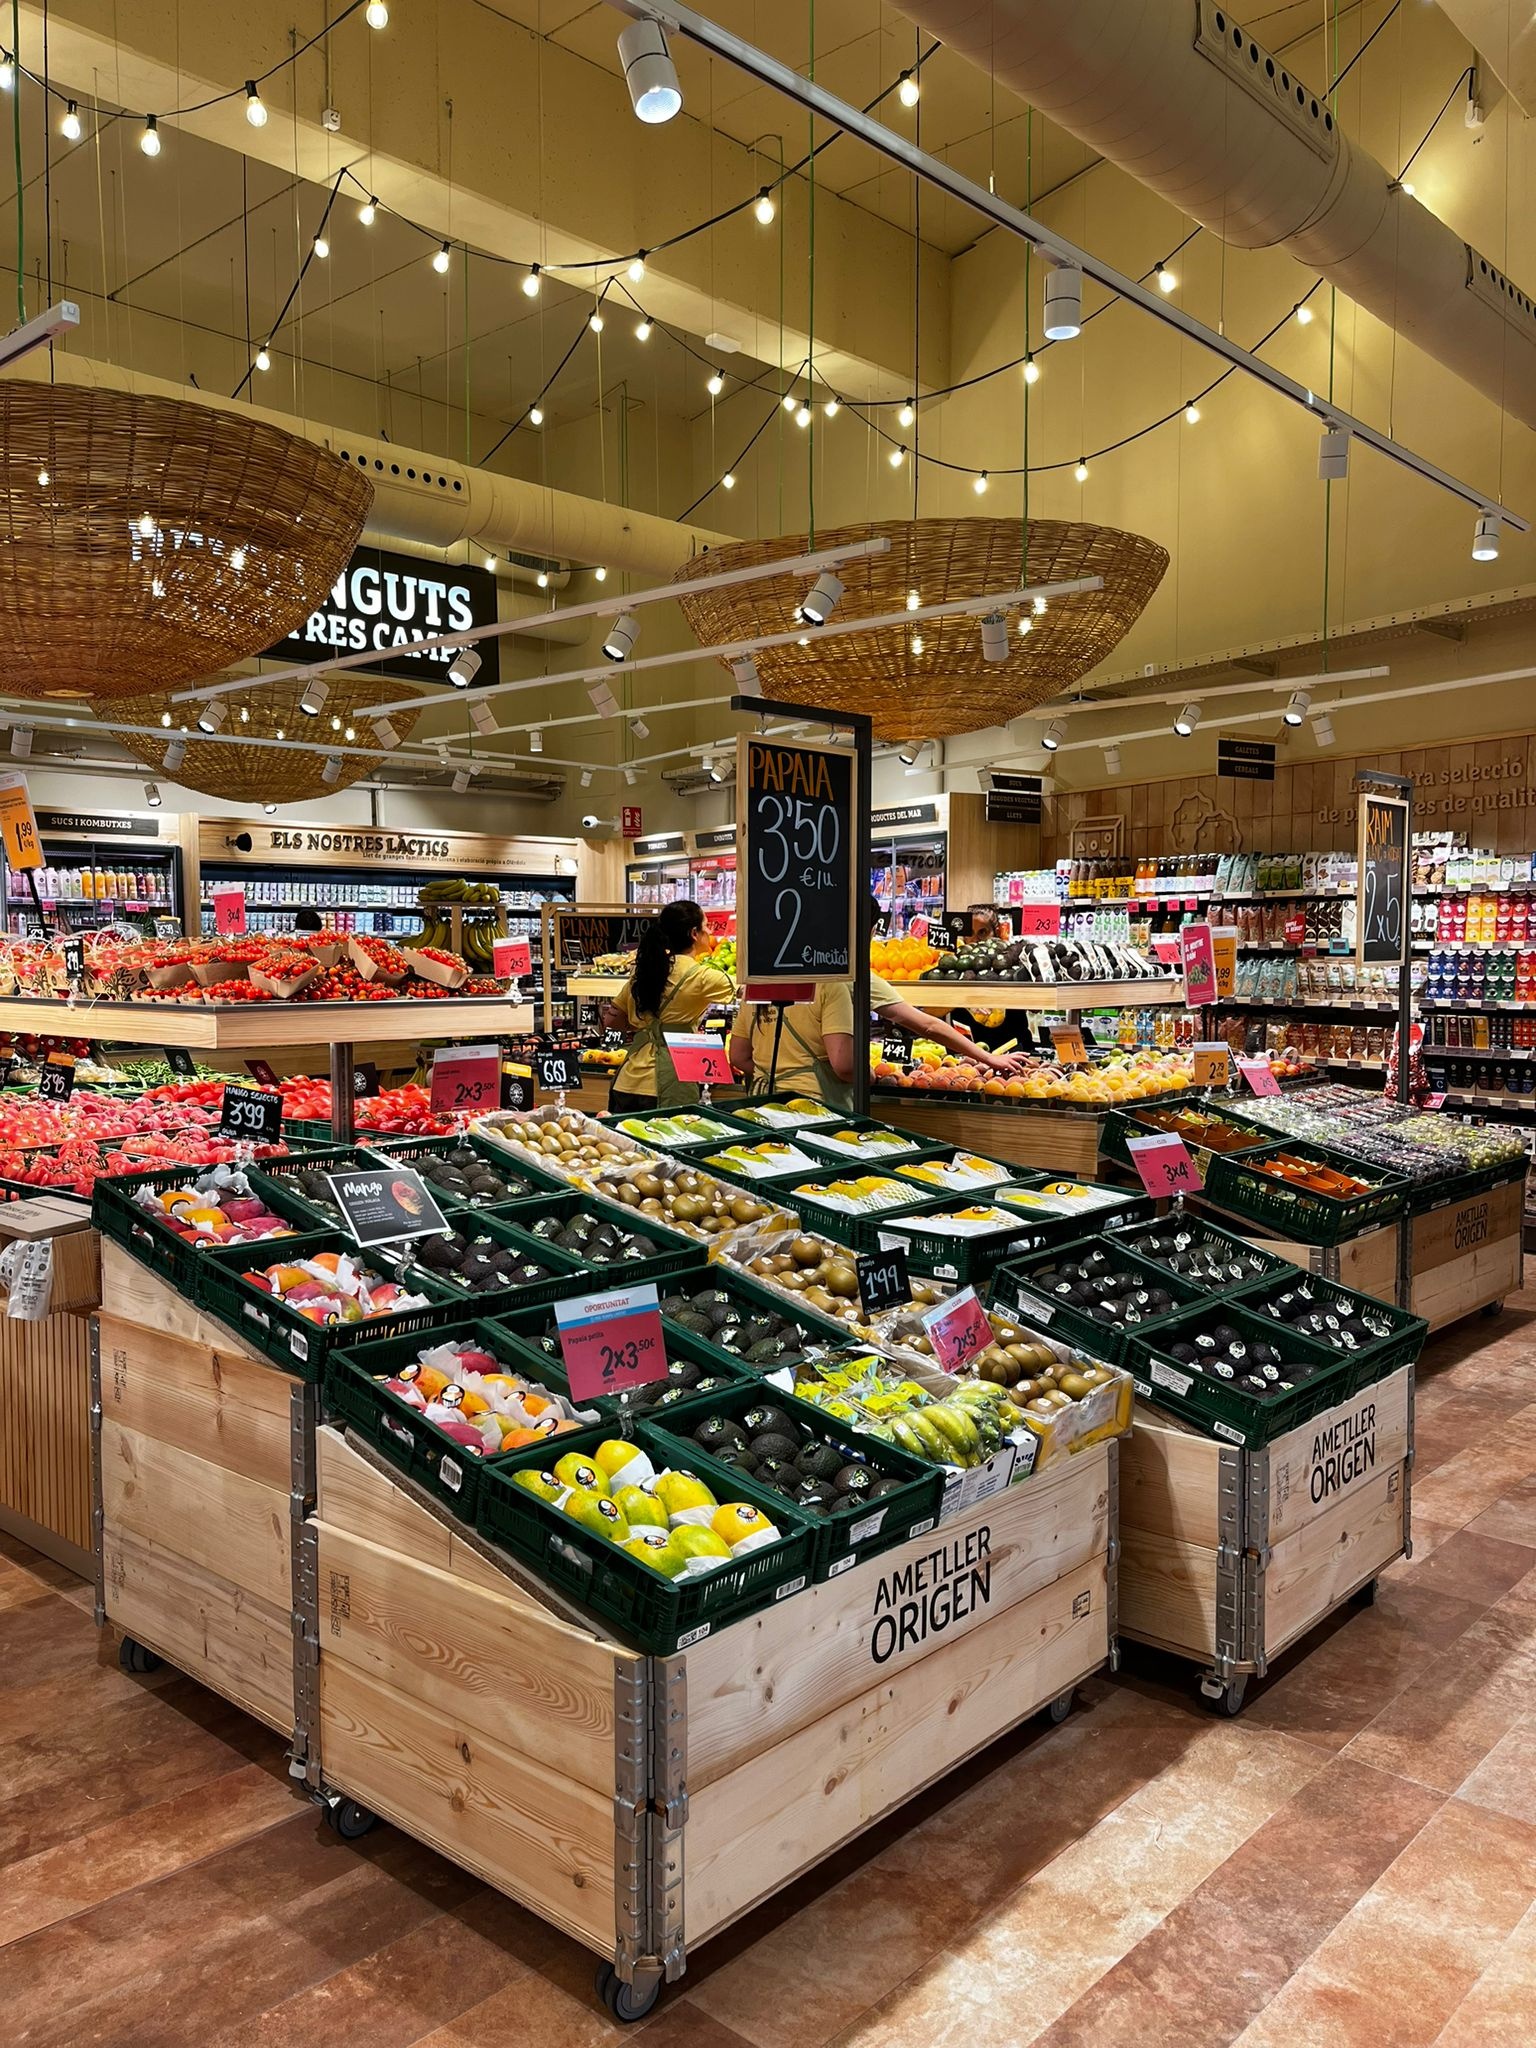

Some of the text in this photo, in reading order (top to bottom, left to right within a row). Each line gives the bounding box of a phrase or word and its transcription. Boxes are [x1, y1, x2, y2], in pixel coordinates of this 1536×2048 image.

[323, 566, 473, 631] NGUTS
[1234, 745, 1260, 755] GALETES
[749, 746, 834, 801] PAPAIA
[1234, 765, 1259, 775] CEREALS
[1439, 756, 1523, 783] selecció
[896, 810, 907, 820] DEL
[908, 808, 921, 818] MAR
[1318, 805, 1340, 824] de
[1441, 792, 1466, 812] de
[1471, 788, 1536, 816] qualit
[51, 817, 132, 829] SUCS I KOMBUTXES
[270, 831, 302, 849] ELS
[307, 832, 383, 852] NOSTRES
[758, 795, 840, 883] 3'50
[382, 853, 404, 862] granges
[773, 888, 804, 968] 2
[929, 931, 950, 947] 2'19
[883, 1044, 906, 1058] 4'49
[229, 1100, 265, 1130] 3'99
[342, 1181, 383, 1198] Mango
[1455, 1202, 1489, 1228] AMETLLER
[1454, 1219, 1489, 1250] ORIGEN
[865, 1264, 900, 1300] 1'99
[584, 1297, 630, 1313] OPORTUNITAT
[1311, 1403, 1376, 1464] AMETLLER
[1310, 1432, 1375, 1504] ORIGEN
[873, 1525, 992, 1616] AMETLLER
[870, 1561, 992, 1664] ORIGEN
